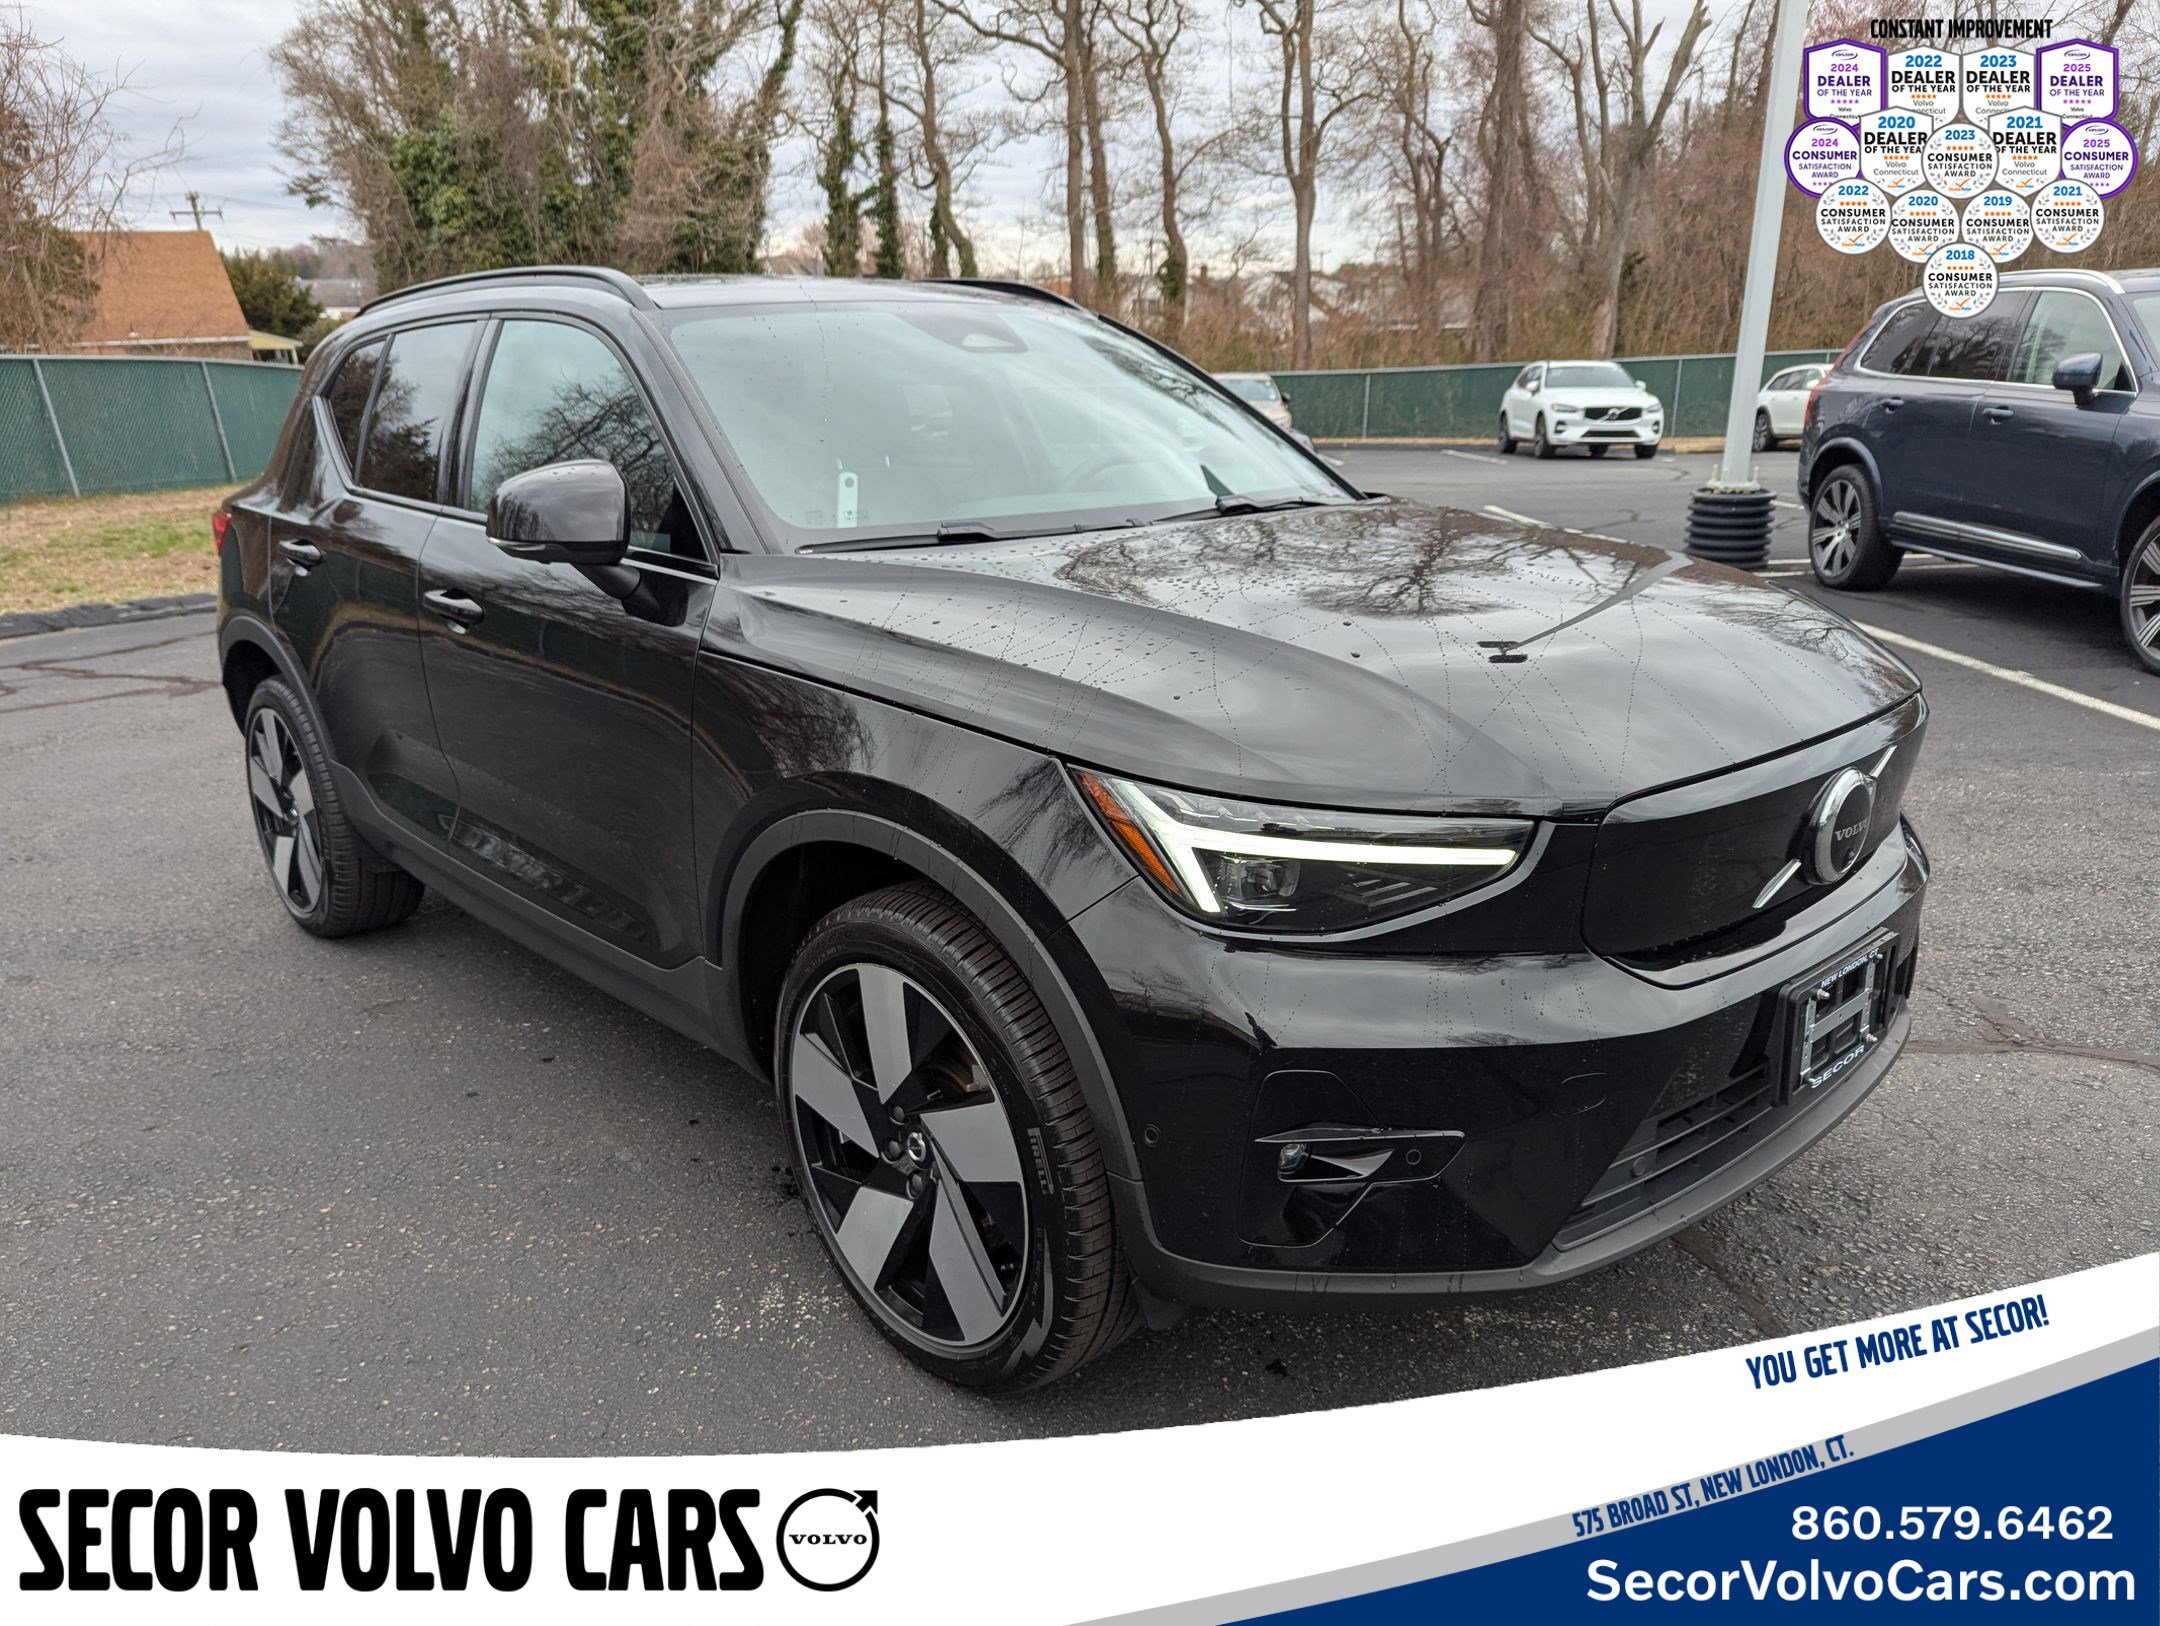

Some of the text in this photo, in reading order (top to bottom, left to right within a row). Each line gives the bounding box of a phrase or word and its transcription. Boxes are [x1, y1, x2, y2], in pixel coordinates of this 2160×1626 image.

[1821, 972, 1839, 988] NEW
[1811, 1044, 1865, 1089] SECOR
[1027, 1127, 1055, 1195] PIRELLI
